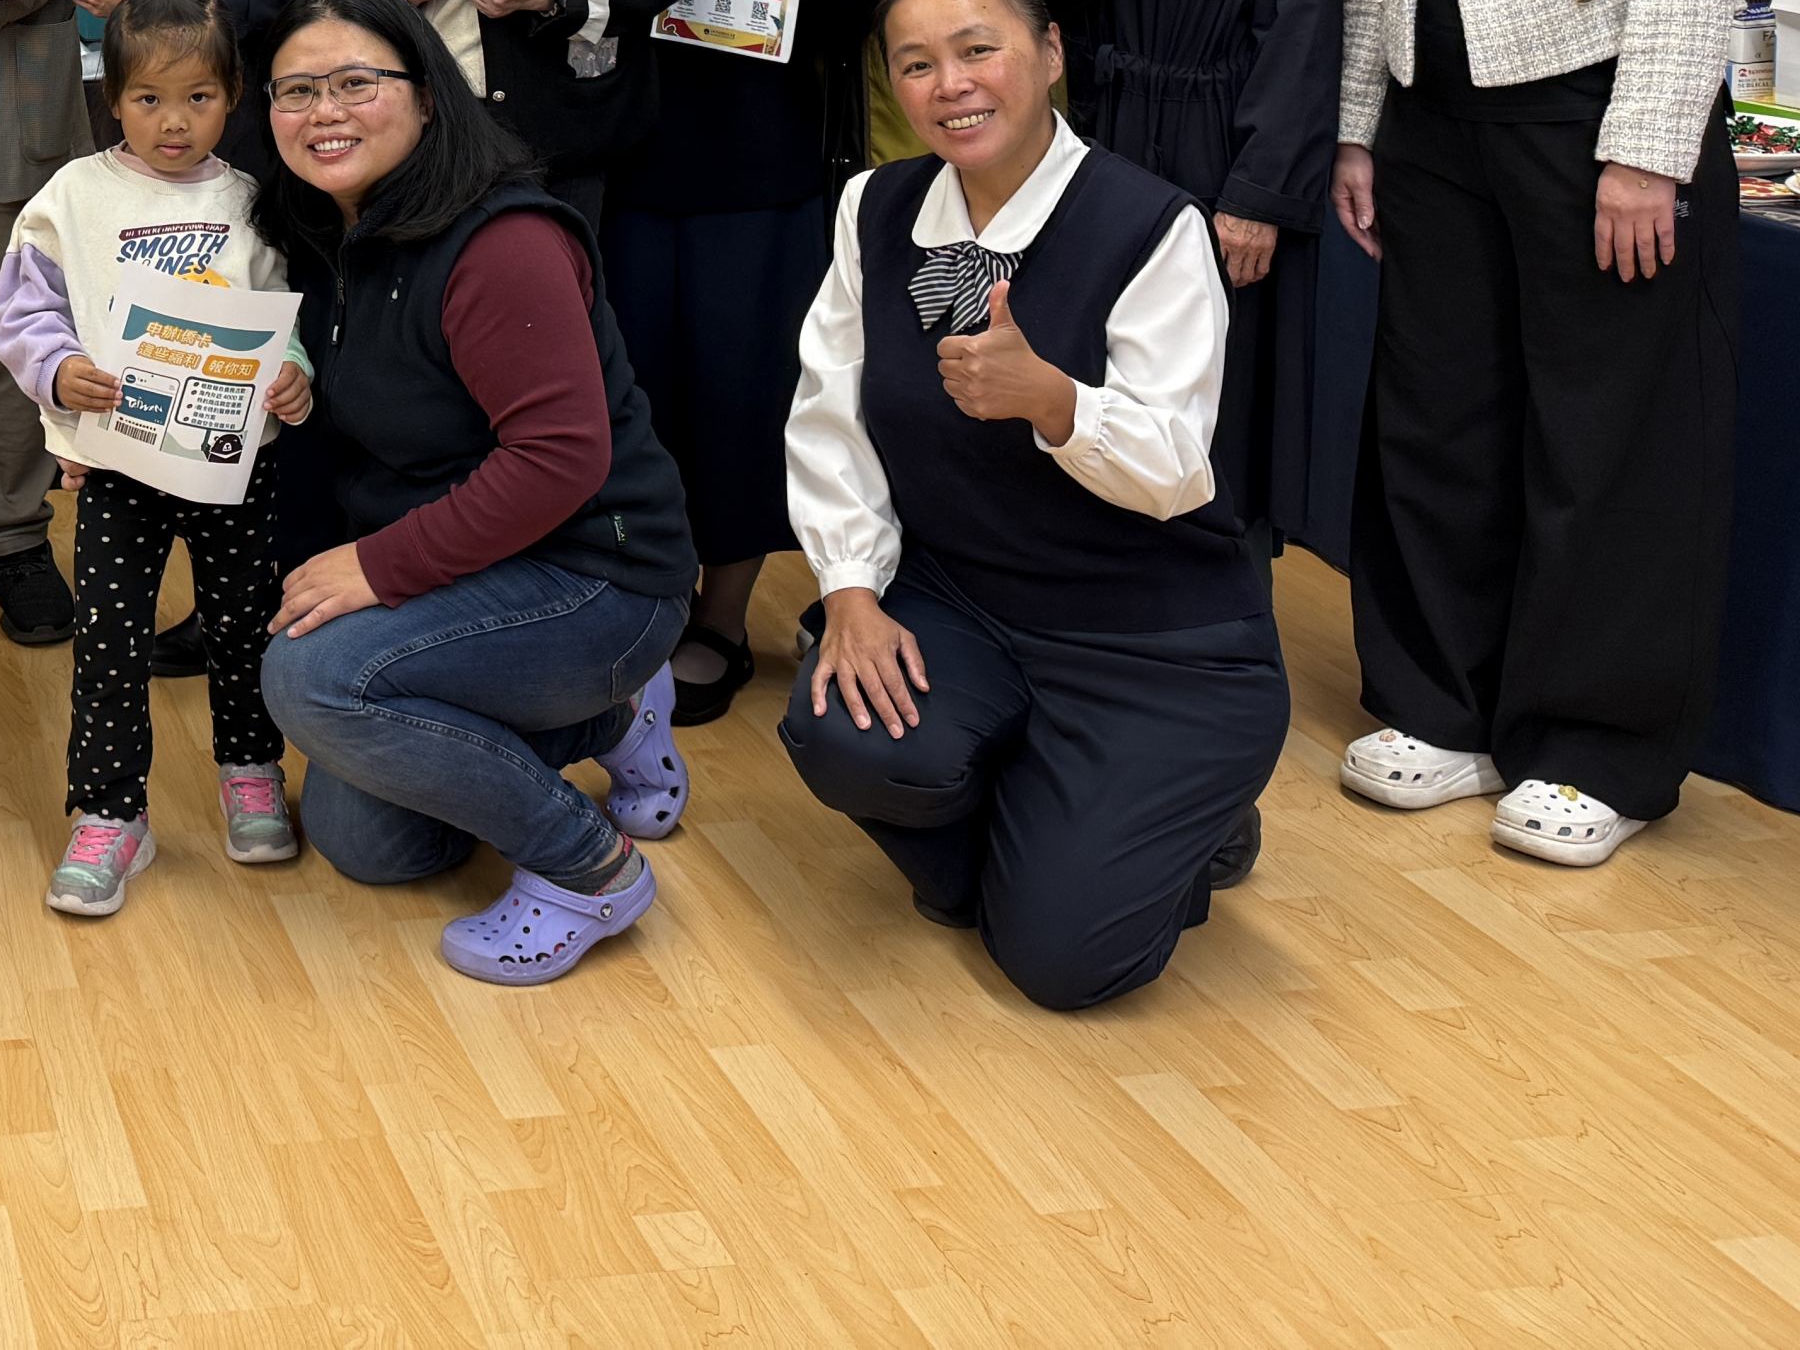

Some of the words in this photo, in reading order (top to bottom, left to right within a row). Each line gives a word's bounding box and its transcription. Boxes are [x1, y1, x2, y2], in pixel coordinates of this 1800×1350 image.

[116, 233, 229, 263] SMOOTH
[155, 253, 211, 275] INES
[137, 342, 202, 369] 這些福利
[208, 359, 253, 377] 報你知
